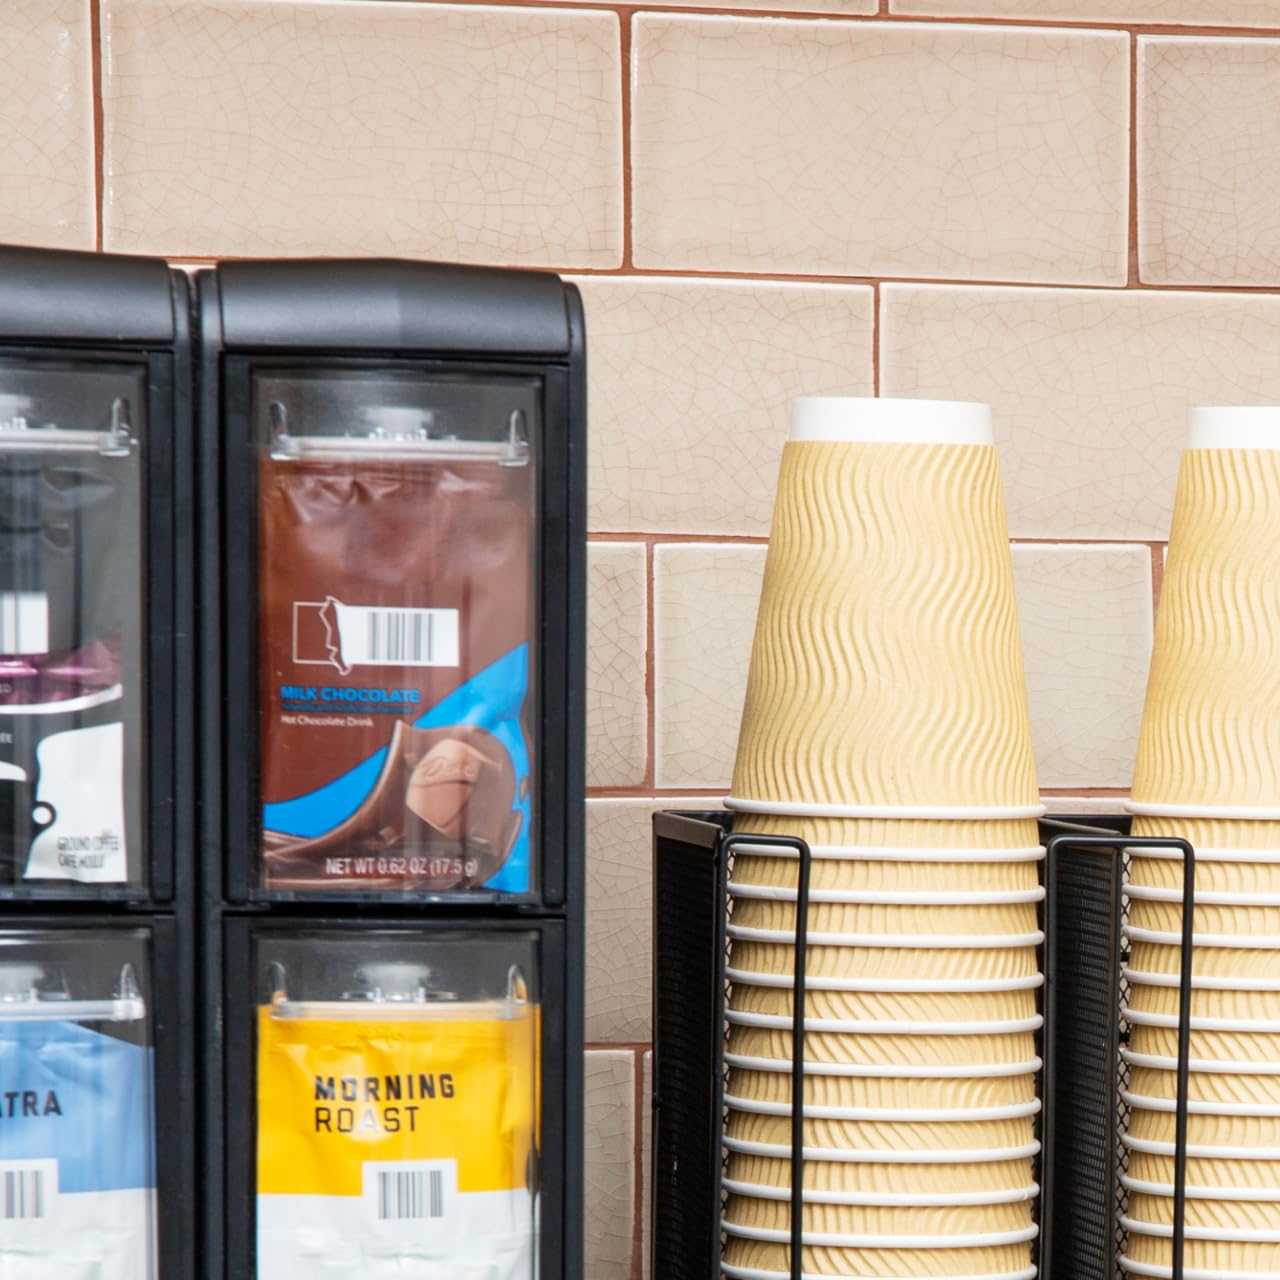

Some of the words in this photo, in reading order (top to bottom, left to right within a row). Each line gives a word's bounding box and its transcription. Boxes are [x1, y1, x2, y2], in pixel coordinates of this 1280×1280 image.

[281, 686, 317, 700] MILK
[320, 687, 421, 703] CHOCOLATE
[297, 715, 345, 726] Chocolate
[346, 717, 374, 727] Drink
[325, 857, 352, 875] NET
[354, 857, 375, 875] WT
[377, 857, 406, 874] 0.62
[409, 857, 427, 874] OZ
[429, 858, 463, 877] (17.5
[464, 859, 478, 878] g)
[315, 1073, 455, 1102] MORNING
[315, 1106, 419, 1133] ROAST
